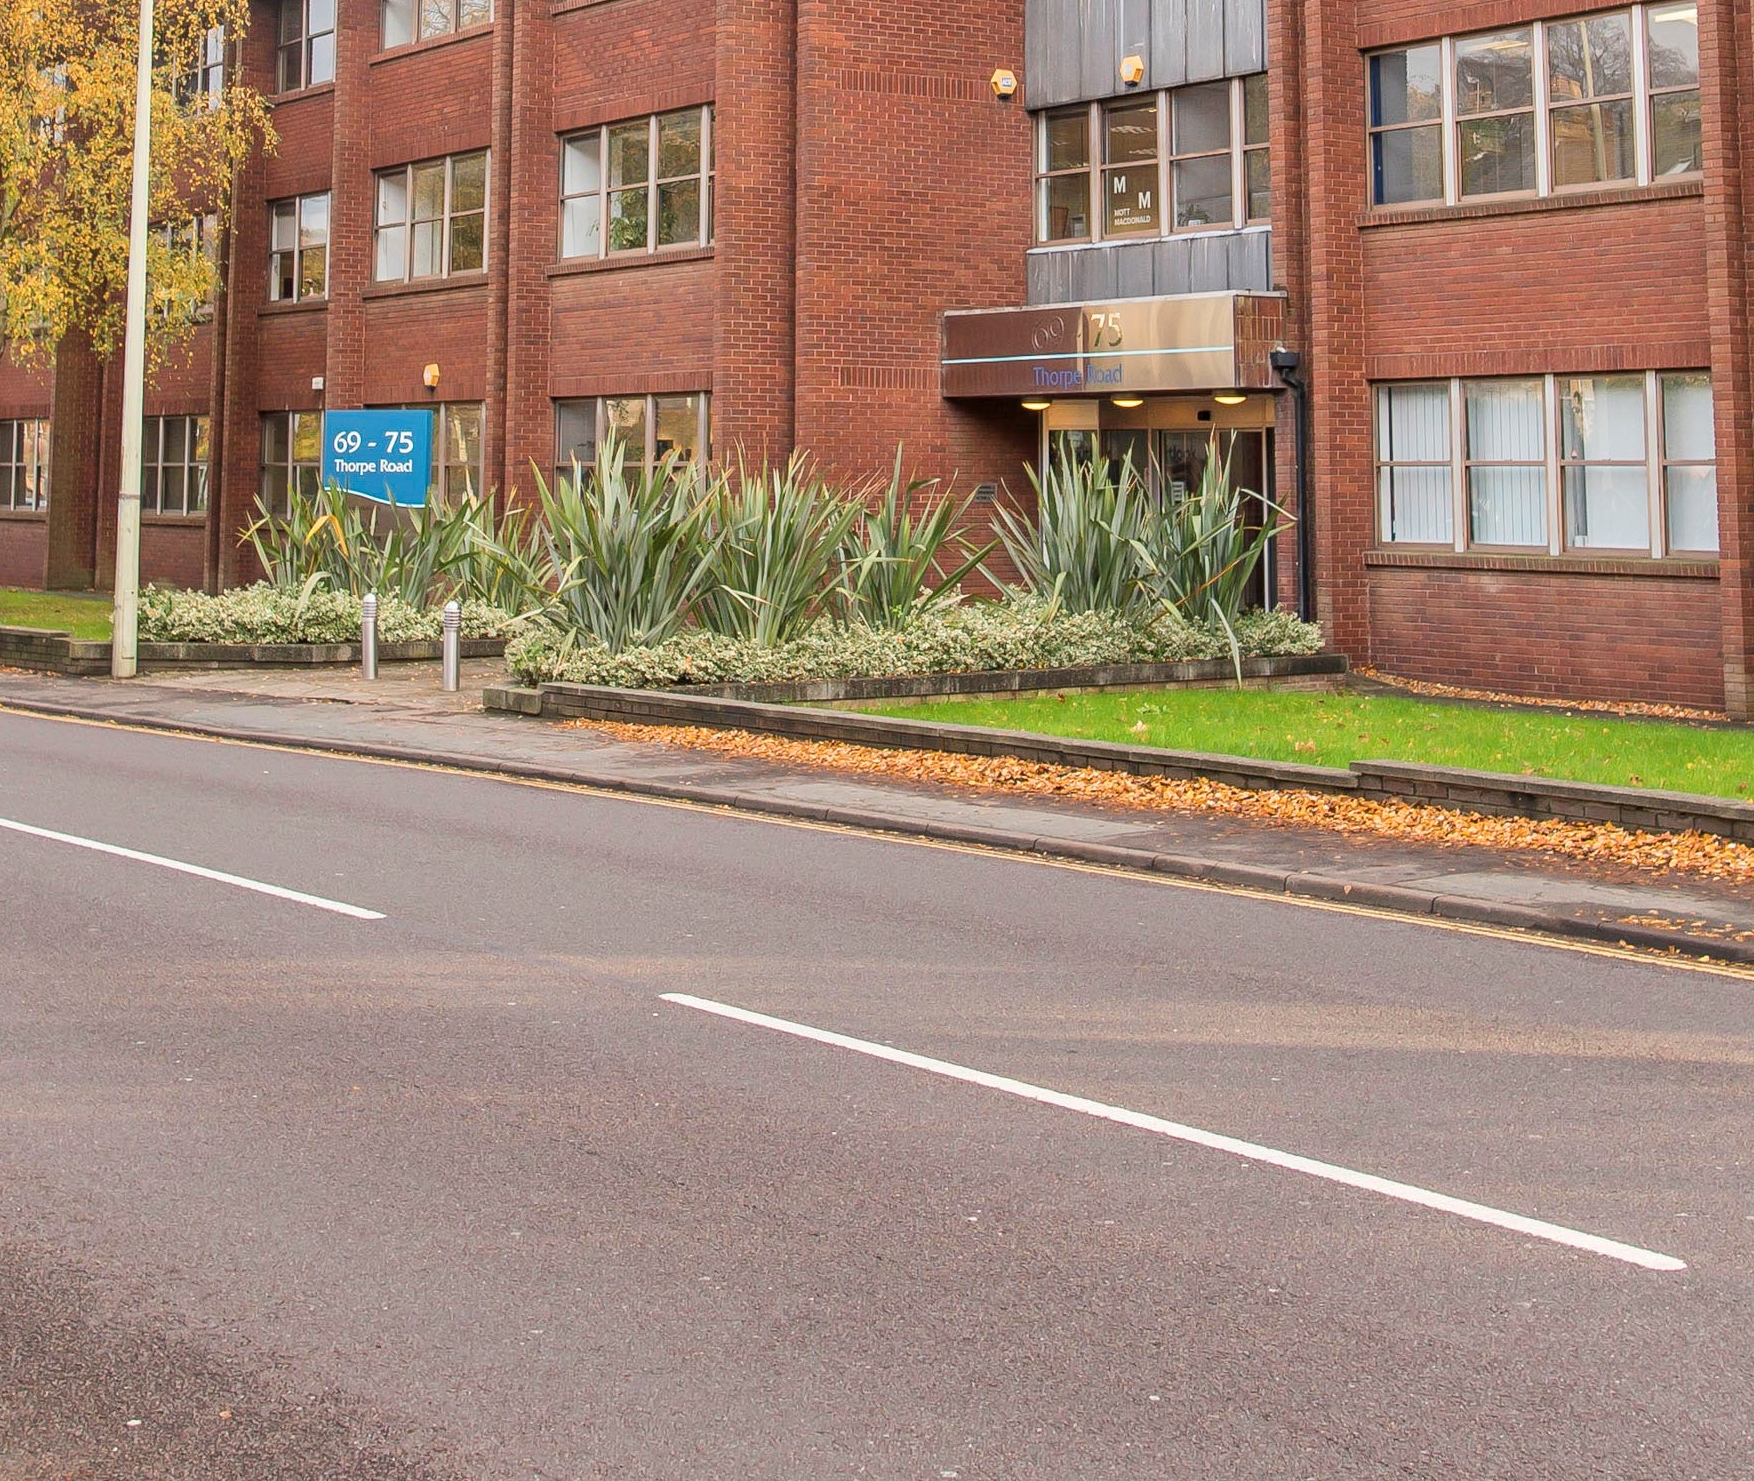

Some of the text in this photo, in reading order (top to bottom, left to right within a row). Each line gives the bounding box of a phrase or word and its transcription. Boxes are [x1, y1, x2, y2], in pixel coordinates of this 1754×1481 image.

[1114, 175, 1126, 194] M
[1138, 191, 1151, 209] M
[1114, 207, 1130, 217] MOTT
[1091, 312, 1123, 347] 75
[1033, 362, 1123, 391] Thorpe Road
[333, 431, 362, 454] 69
[384, 431, 414, 454] 75
[334, 458, 413, 476] Thorpe Road
